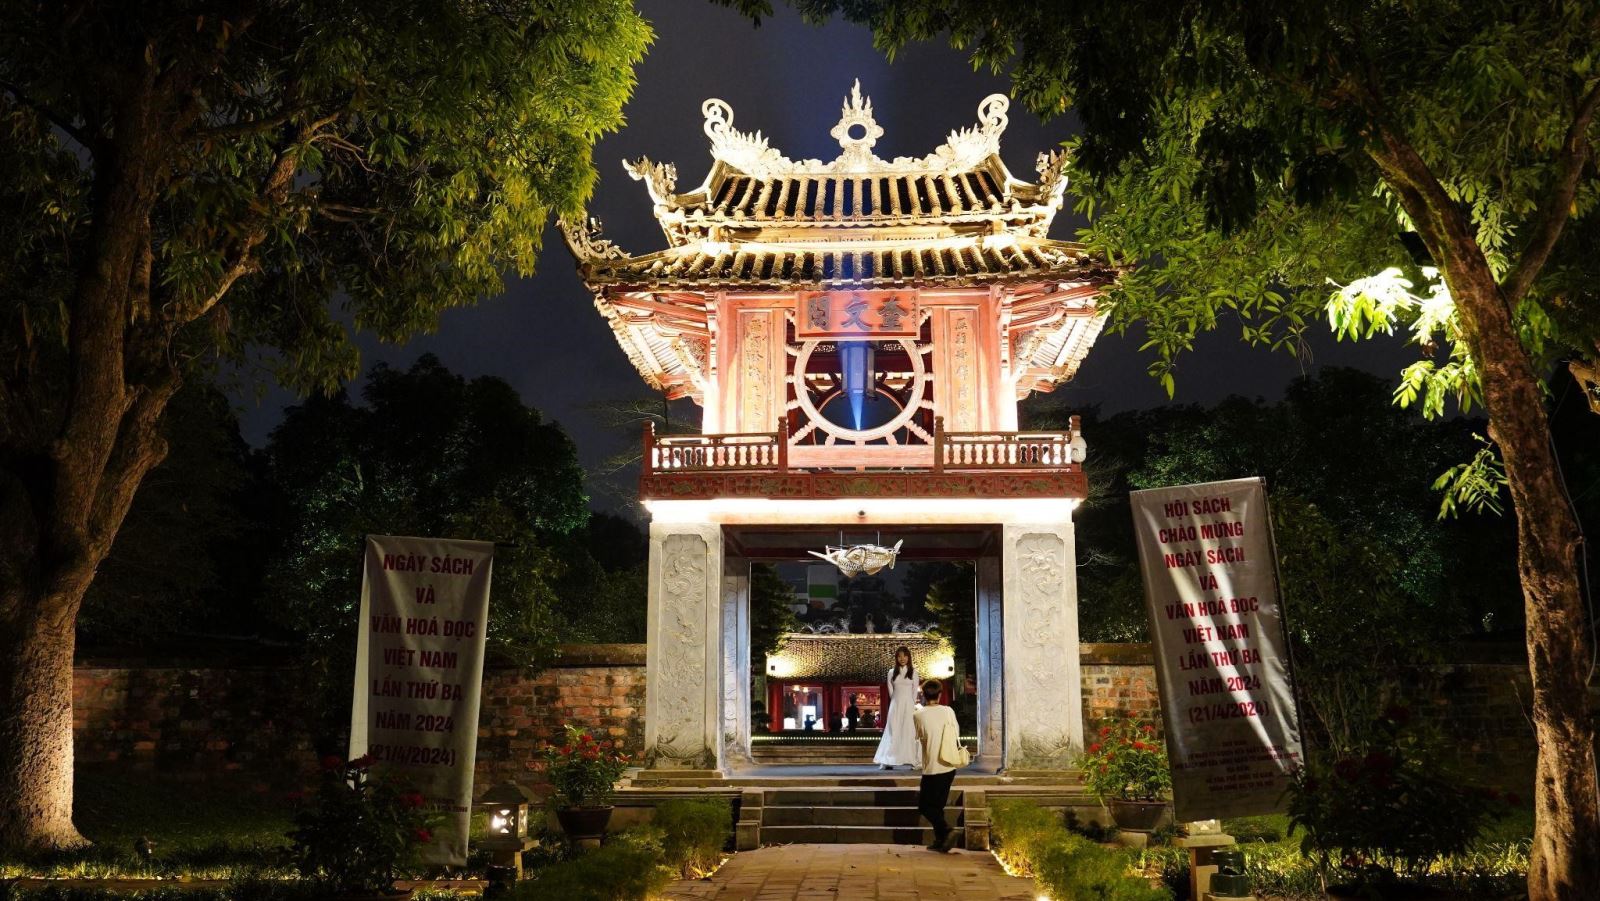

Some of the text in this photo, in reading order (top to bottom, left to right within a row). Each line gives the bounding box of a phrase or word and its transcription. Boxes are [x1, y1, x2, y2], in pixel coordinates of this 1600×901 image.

[1164, 497, 1231, 520] HỘI SÁCH
[1159, 521, 1244, 544] CHÀO MỪNG
[383, 552, 474, 575] NGÀY SÁCH
[1164, 546, 1245, 569] NGÀY SÁCH
[1199, 572, 1219, 591] VÀ
[415, 584, 435, 604] VÀ
[1165, 597, 1259, 620] VĂN HOÁ ĐỌC
[371, 615, 475, 641] VĂN HOÁ ĐỌC
[1183, 624, 1249, 645] VIỆT NAM
[384, 646, 458, 669] VIỆT NAM
[1211, 649, 1239, 667] THỨ
[1242, 649, 1262, 664] BA
[406, 679, 438, 699] THỨ
[441, 684, 462, 701] BA
[1188, 675, 1261, 696] NĂM 2024
[375, 710, 455, 733] NĂM 2024
[1188, 700, 1270, 724] (21/4/2024)
[368, 744, 456, 767] (21/4/2024)
